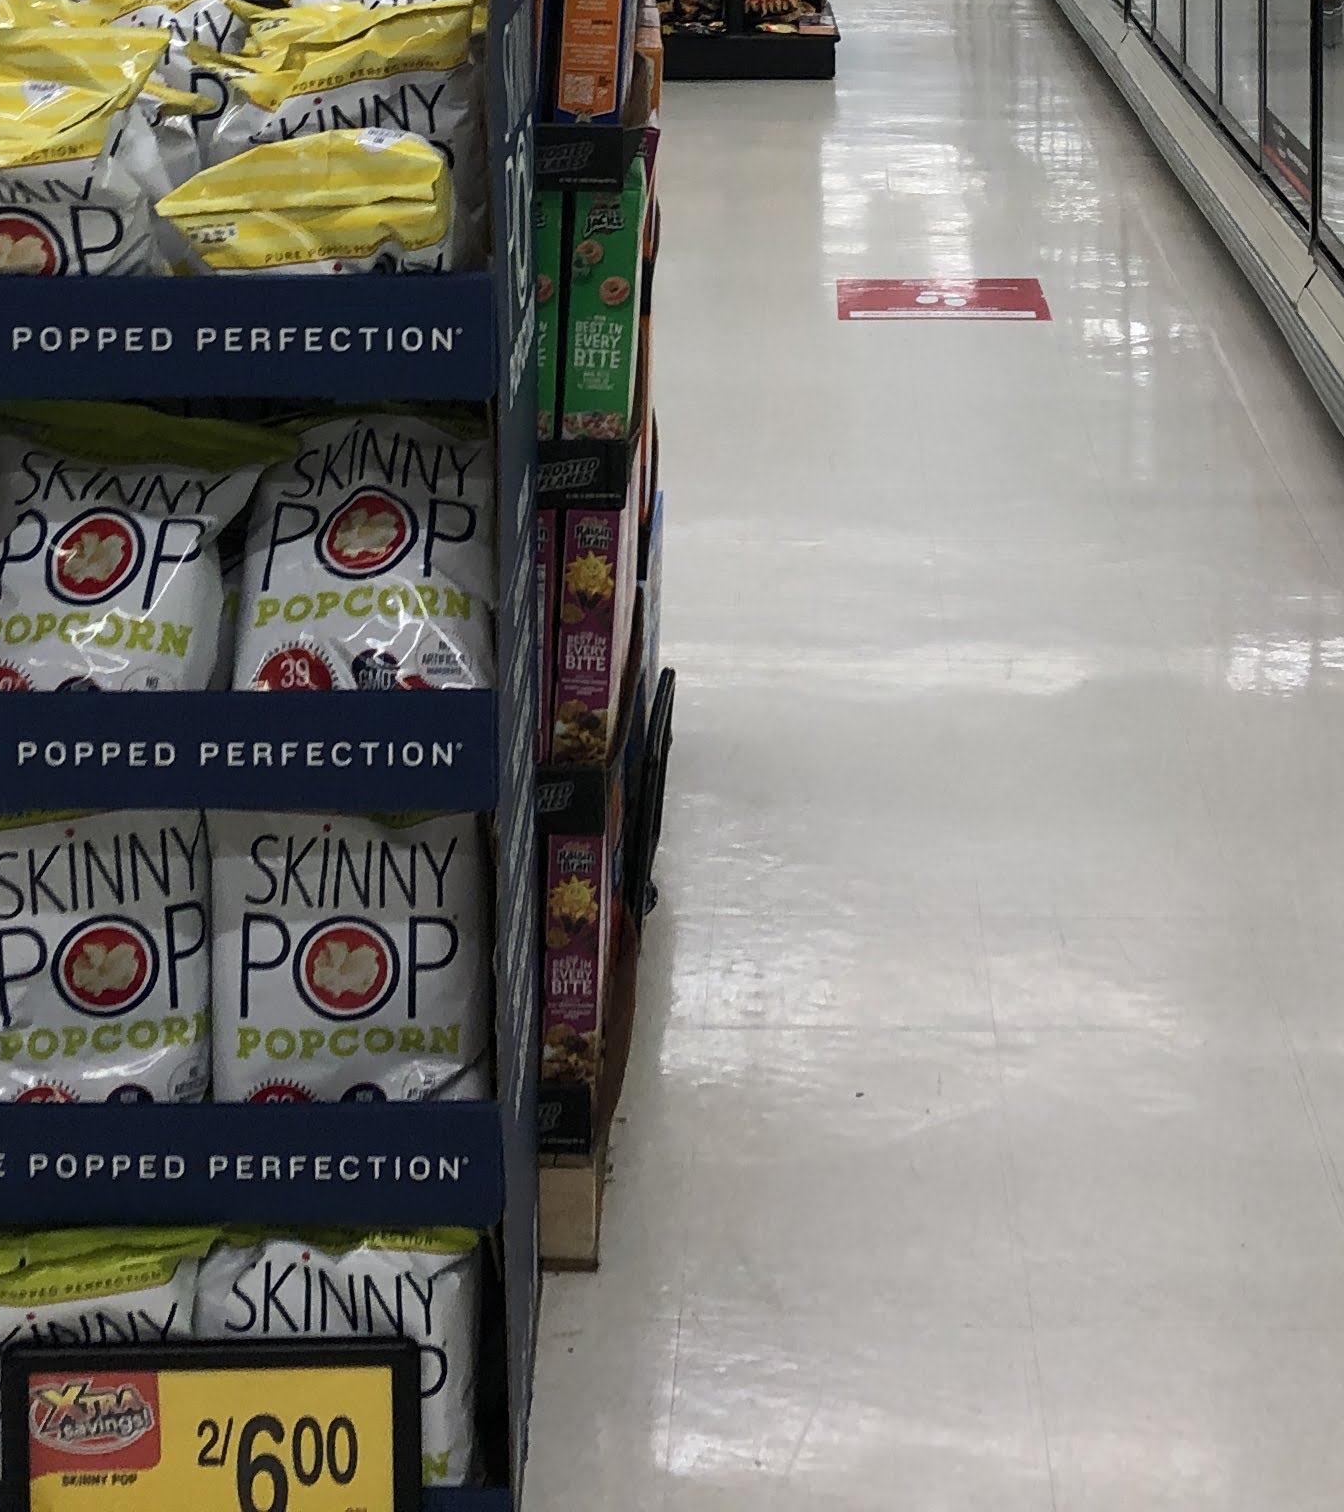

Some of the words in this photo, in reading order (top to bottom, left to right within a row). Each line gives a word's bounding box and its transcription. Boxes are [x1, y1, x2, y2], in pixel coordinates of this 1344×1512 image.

[248, 83, 446, 145] KINNY
[12, 325, 174, 353] POPPED
[574, 333, 622, 348] EVERY
[575, 320, 604, 334] BEST
[608, 321, 624, 335] IN
[573, 349, 621, 370] BITE
[261, 485, 478, 593] POP
[255, 585, 473, 629] POPCORN
[565, 644, 608, 658] EVERY
[565, 656, 607, 672] BITE
[279, 657, 310, 689] 39
[17, 740, 177, 767] POPPED
[239, 914, 458, 1022] POP
[552, 969, 593, 982] EVERY
[551, 980, 593, 996] BITE
[236, 1023, 459, 1061] POPCORN
[29, 1152, 186, 1180] POPPED
[61, 1474, 108, 1486] SKINNY
[111, 1474, 138, 1486] POP
